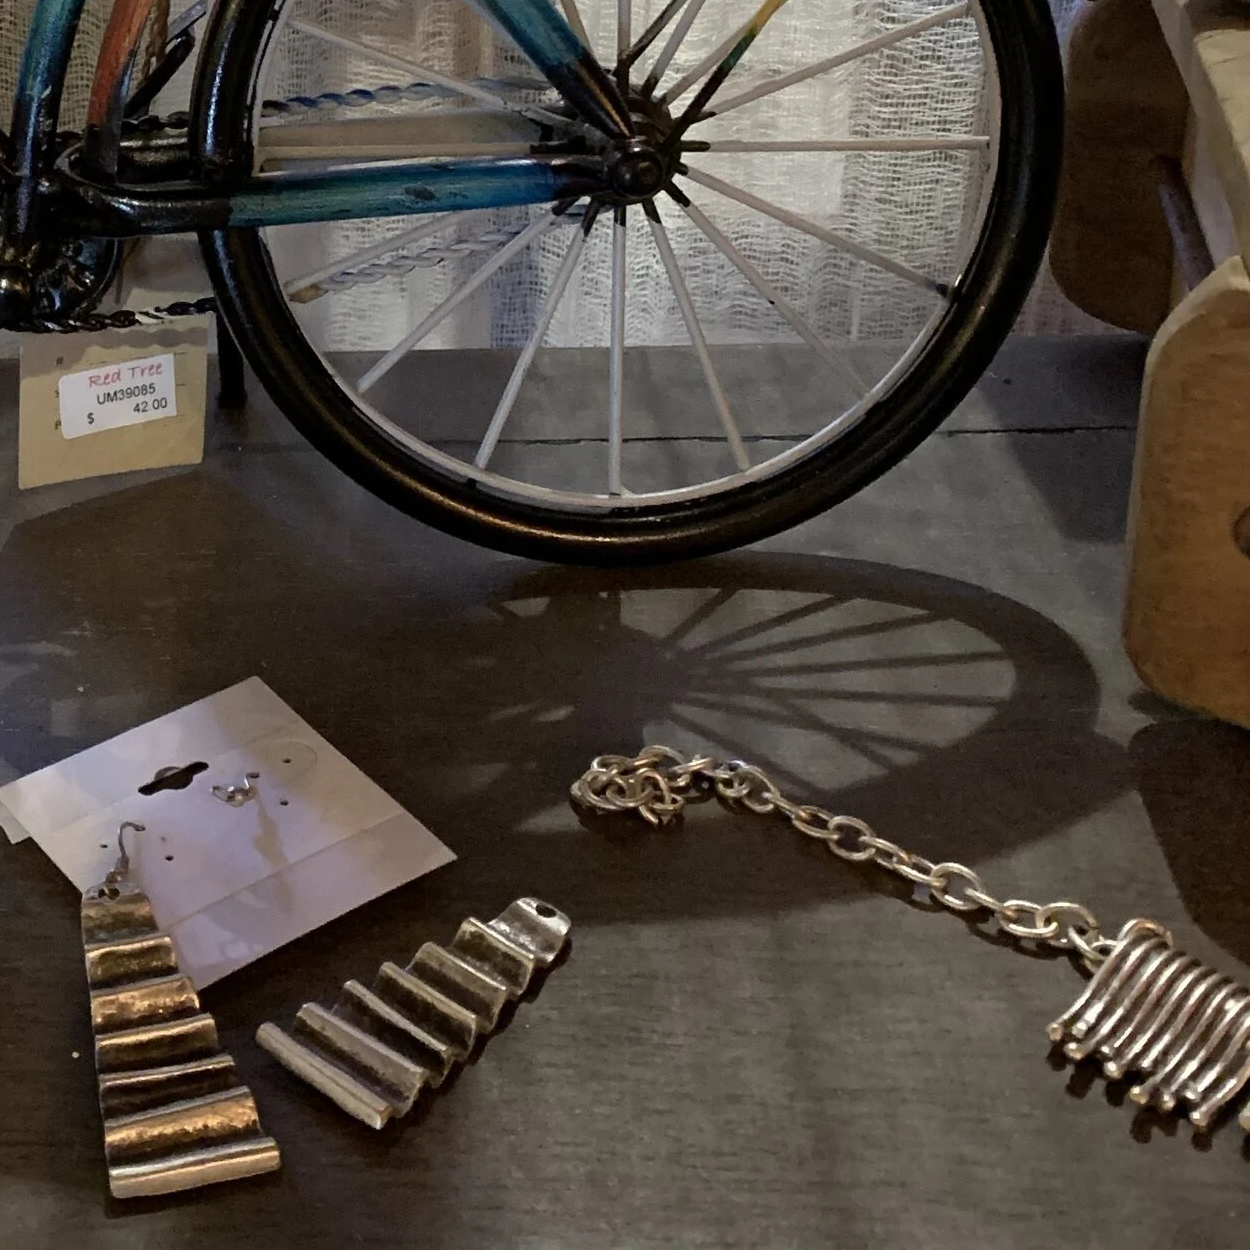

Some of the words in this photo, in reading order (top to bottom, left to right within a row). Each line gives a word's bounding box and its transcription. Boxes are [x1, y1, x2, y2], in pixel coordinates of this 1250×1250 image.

[88, 369, 121, 388] Red
[128, 362, 163, 379] Tree
[96, 382, 156, 405] UM39085
[86, 412, 95, 425] $
